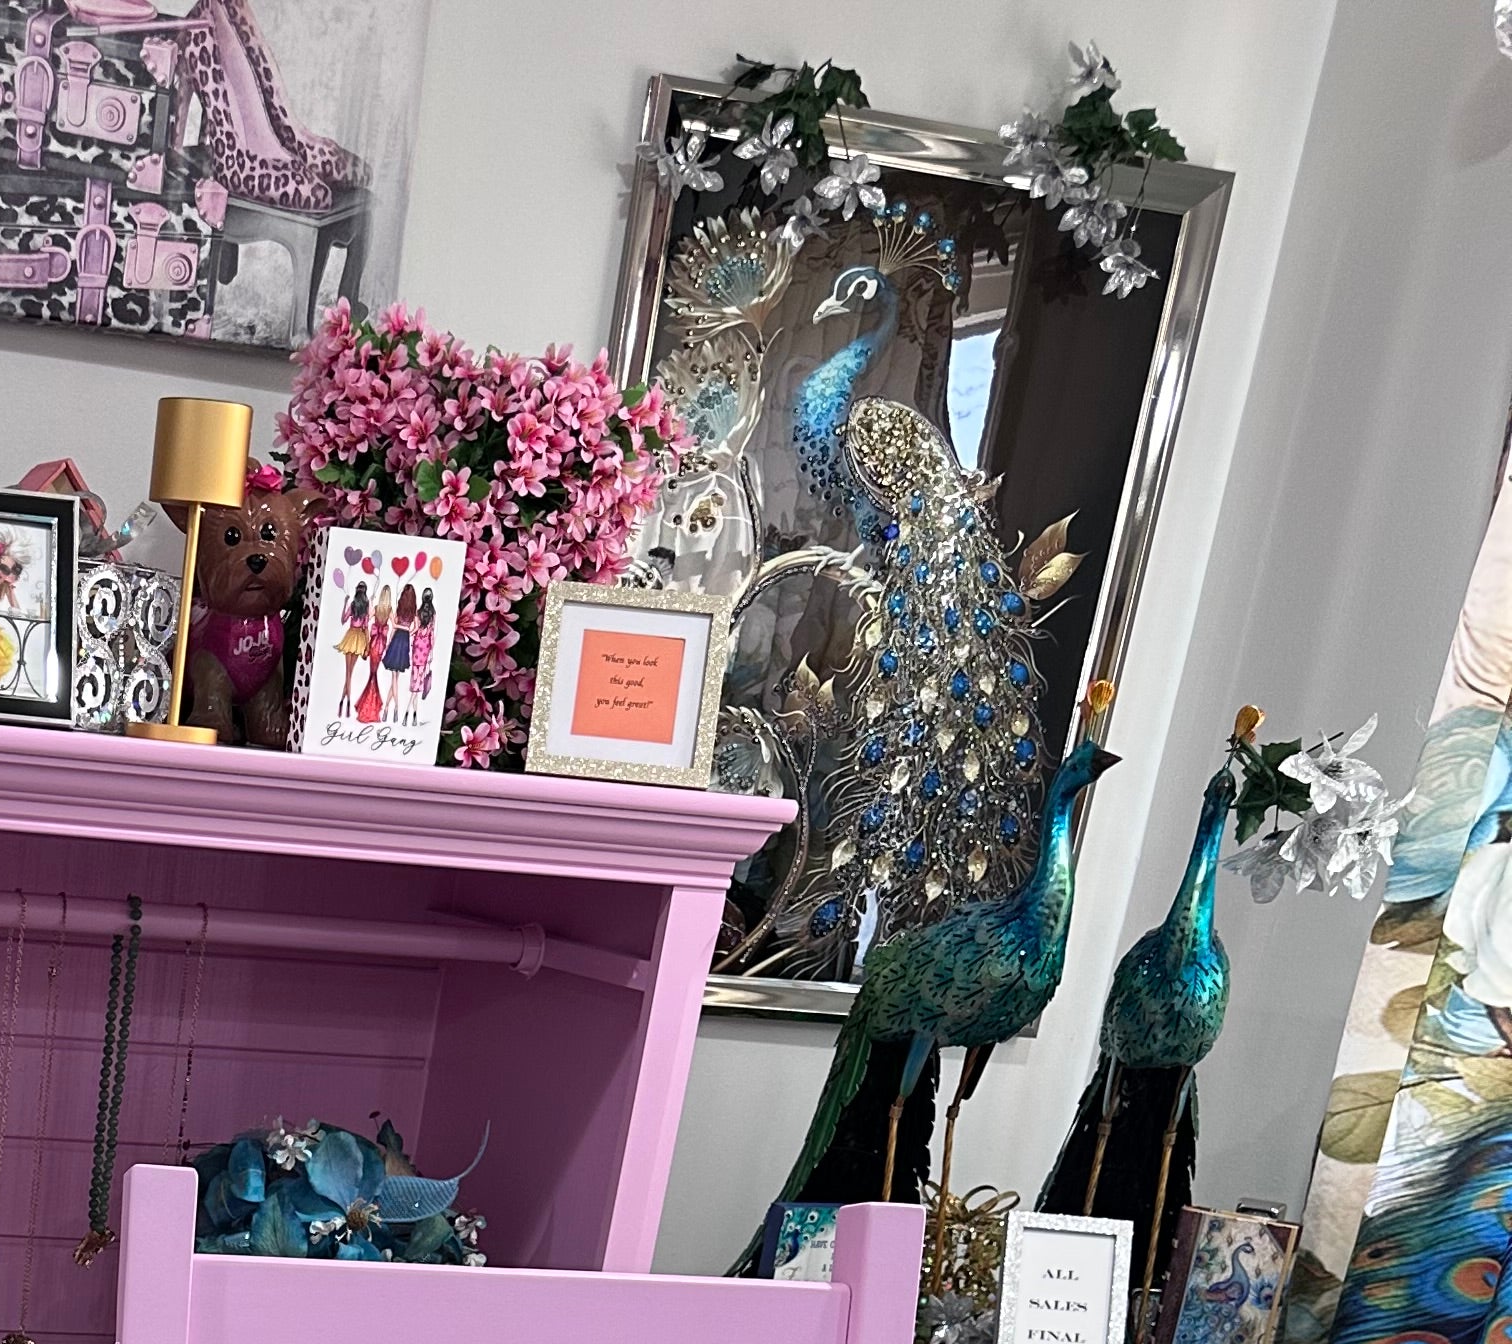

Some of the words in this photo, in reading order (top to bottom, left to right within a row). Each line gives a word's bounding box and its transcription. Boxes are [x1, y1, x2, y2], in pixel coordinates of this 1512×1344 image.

[624, 658, 641, 669] you
[642, 655, 660, 667] look
[609, 674, 624, 685] this
[594, 698, 610, 709] you
[320, 720, 375, 746] Girl
[370, 726, 423, 756] Gang
[1042, 1268, 1080, 1281] ALL
[1028, 1299, 1088, 1313] SALES
[1028, 1329, 1087, 1344] FINAL
